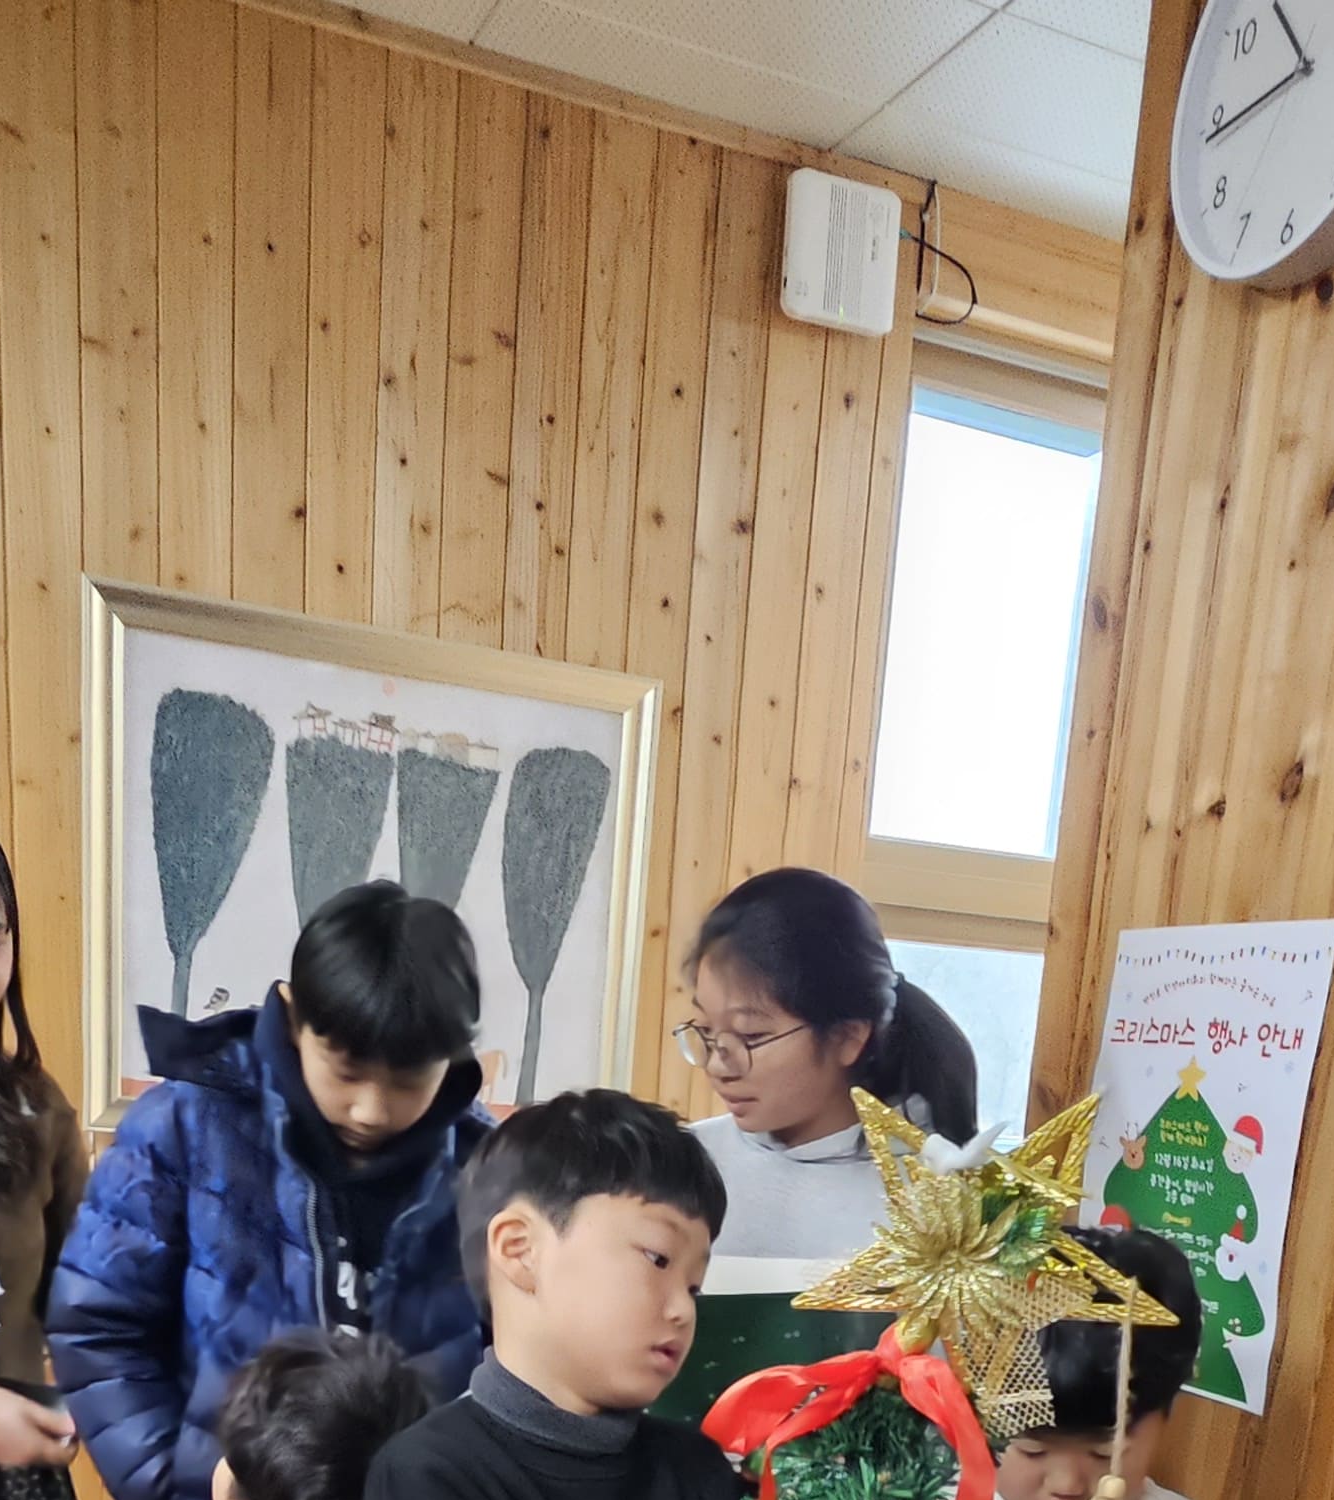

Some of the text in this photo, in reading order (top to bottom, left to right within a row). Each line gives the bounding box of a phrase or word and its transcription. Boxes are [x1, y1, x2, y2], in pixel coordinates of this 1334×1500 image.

[1233, 17, 1258, 61] 10
[1212, 175, 1228, 209] 8
[1237, 211, 1252, 249] 7
[1279, 208, 1295, 245] 6
[1110, 1015, 1304, 1057] 크리스마스 행사 안내
